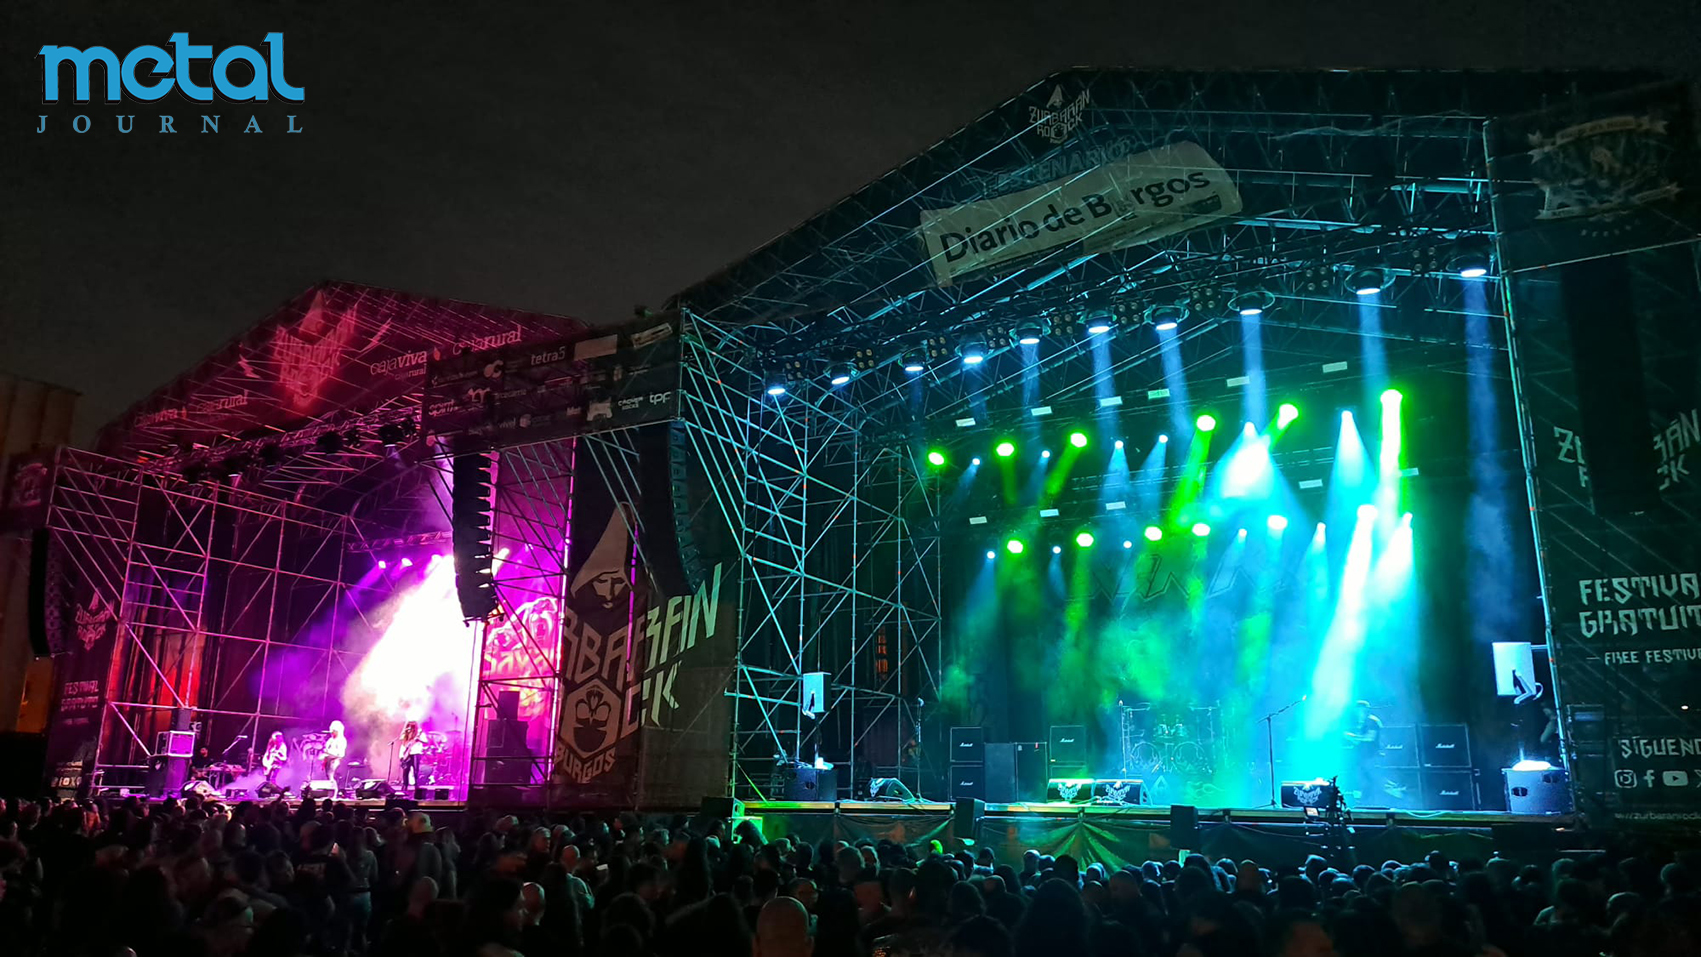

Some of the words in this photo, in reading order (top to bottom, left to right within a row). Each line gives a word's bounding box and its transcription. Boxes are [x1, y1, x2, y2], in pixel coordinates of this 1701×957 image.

[940, 217, 1040, 263] Diario
[1044, 203, 1086, 233] de
[530, 346, 567, 366] tetra5
[1604, 651, 1640, 666] FREE
